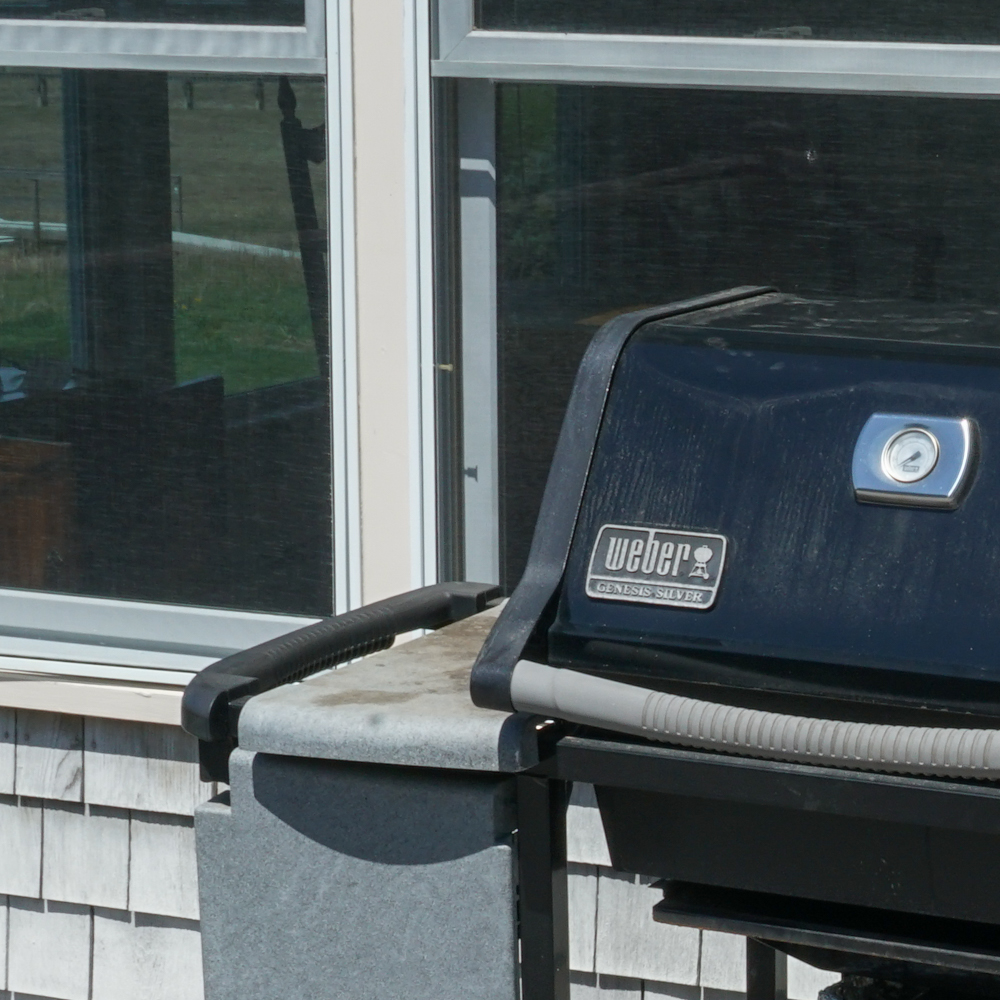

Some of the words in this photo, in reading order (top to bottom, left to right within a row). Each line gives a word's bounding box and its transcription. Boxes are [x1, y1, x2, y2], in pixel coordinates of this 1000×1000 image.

[605, 532, 691, 577] weber
[596, 582, 651, 597] GENESIS
[655, 588, 703, 602] SILVER
